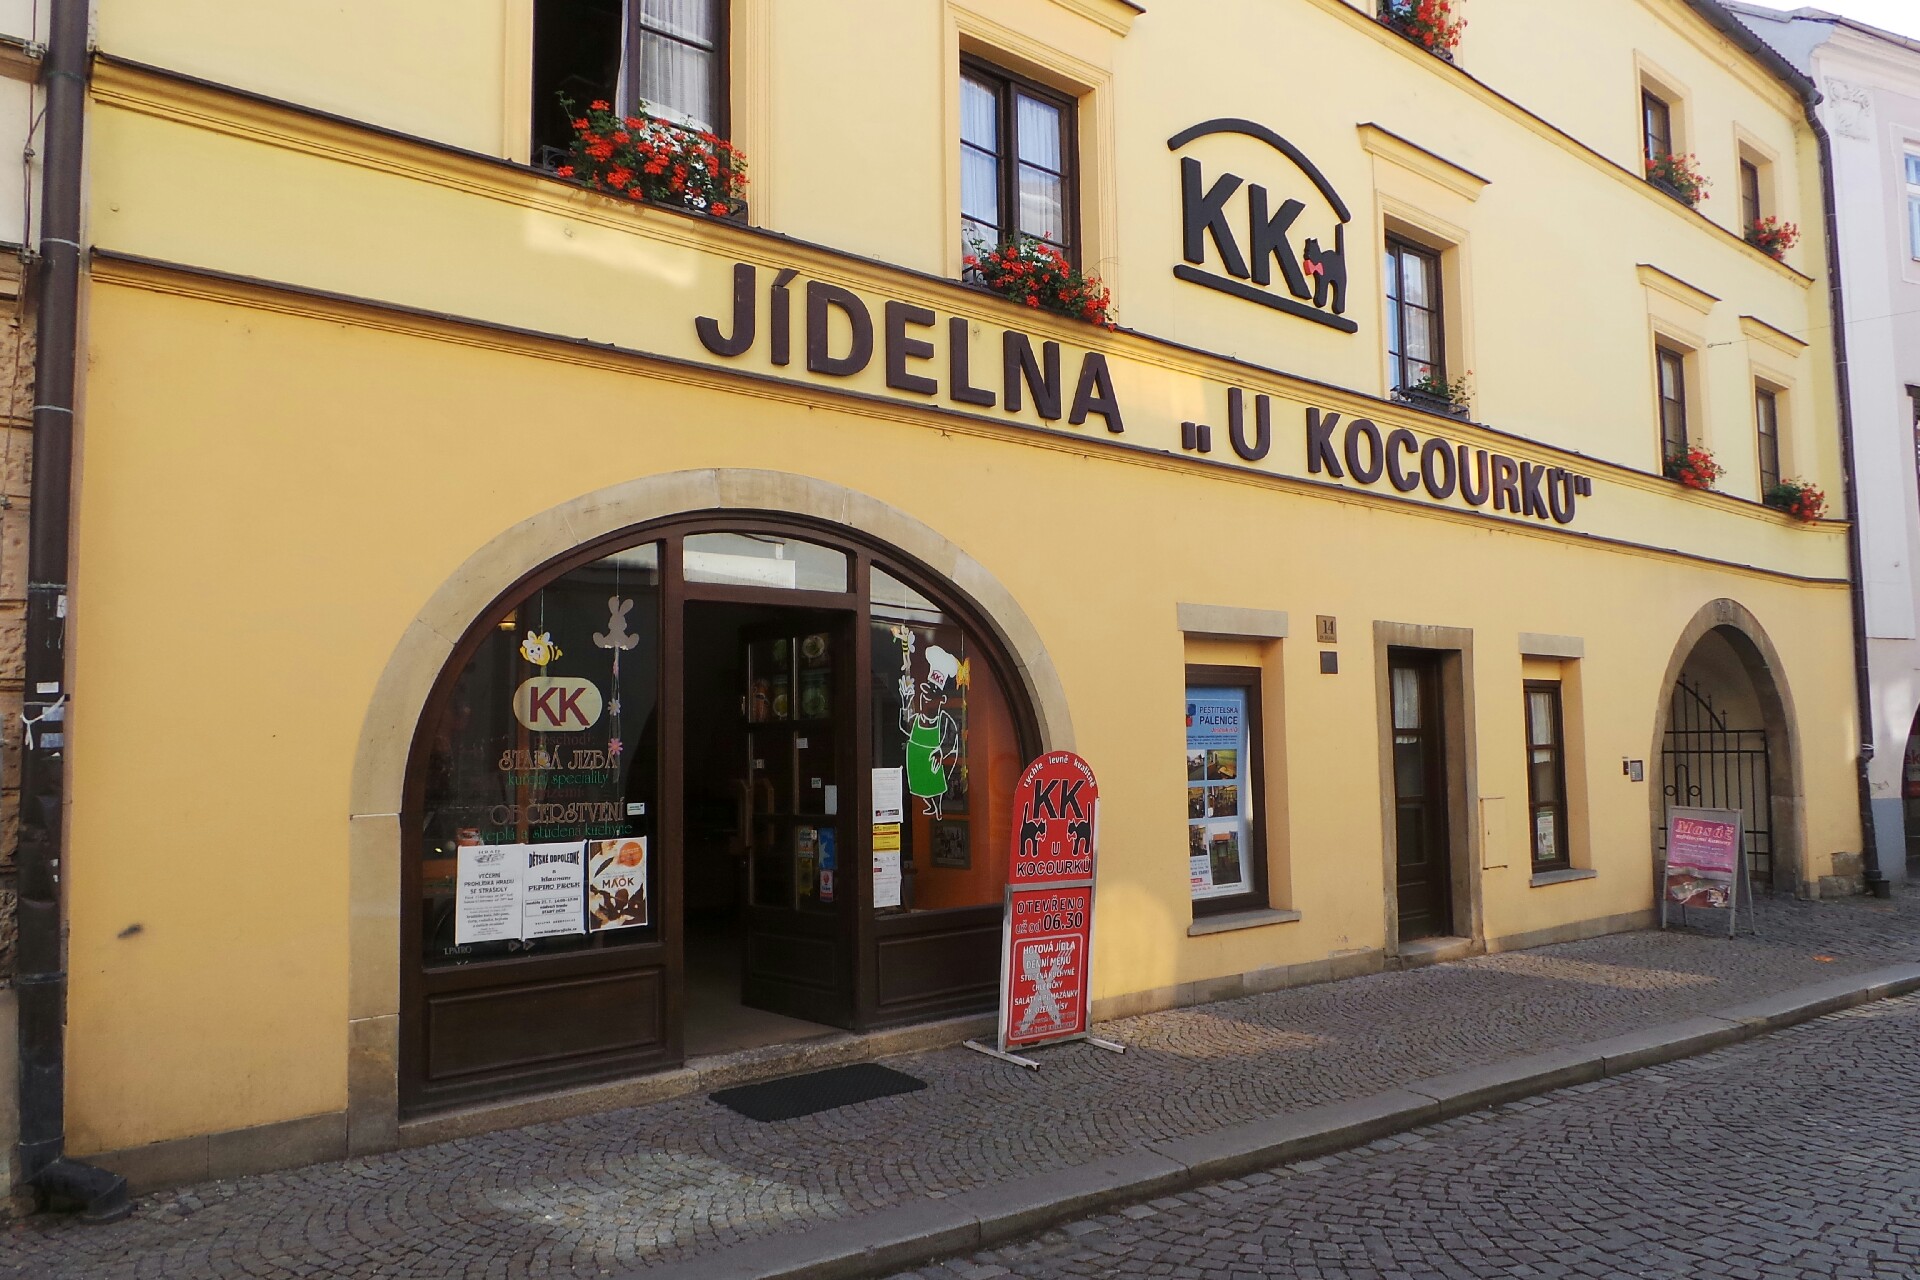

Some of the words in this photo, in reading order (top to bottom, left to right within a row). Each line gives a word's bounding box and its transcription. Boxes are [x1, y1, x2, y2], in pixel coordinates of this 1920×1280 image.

[1181, 156, 1313, 301] KK
[694, 262, 1126, 434] JÍDELNA
[1323, 620, 1335, 635] 14
[529, 686, 591, 727] KK
[1199, 712, 1238, 725] PÁLENICE
[498, 745, 564, 771] STARÁ
[567, 749, 618, 770] JIZBA
[552, 769, 609, 789] speciality
[1023, 762, 1044, 789] rychle
[1049, 754, 1069, 765] levně
[1073, 757, 1096, 789] kvalitně
[1032, 779, 1085, 820] KK
[490, 796, 625, 826] OBČERSTVENÍ
[532, 822, 582, 840] studená
[528, 850, 549, 869] DĚTSKÉ
[549, 850, 580, 865] ODPOLEDNE
[1051, 841, 1061, 856] U
[1016, 856, 1092, 878] KOCOURKŮ
[1016, 894, 1085, 916] OTEVŘENO
[1015, 919, 1028, 934] už
[1028, 918, 1042, 933] od
[1042, 911, 1084, 932] 06.30
[1023, 940, 1054, 955] HOTOVÁ
[1054, 939, 1076, 952] JÍDLA
[1026, 955, 1050, 969] DENNÍ
